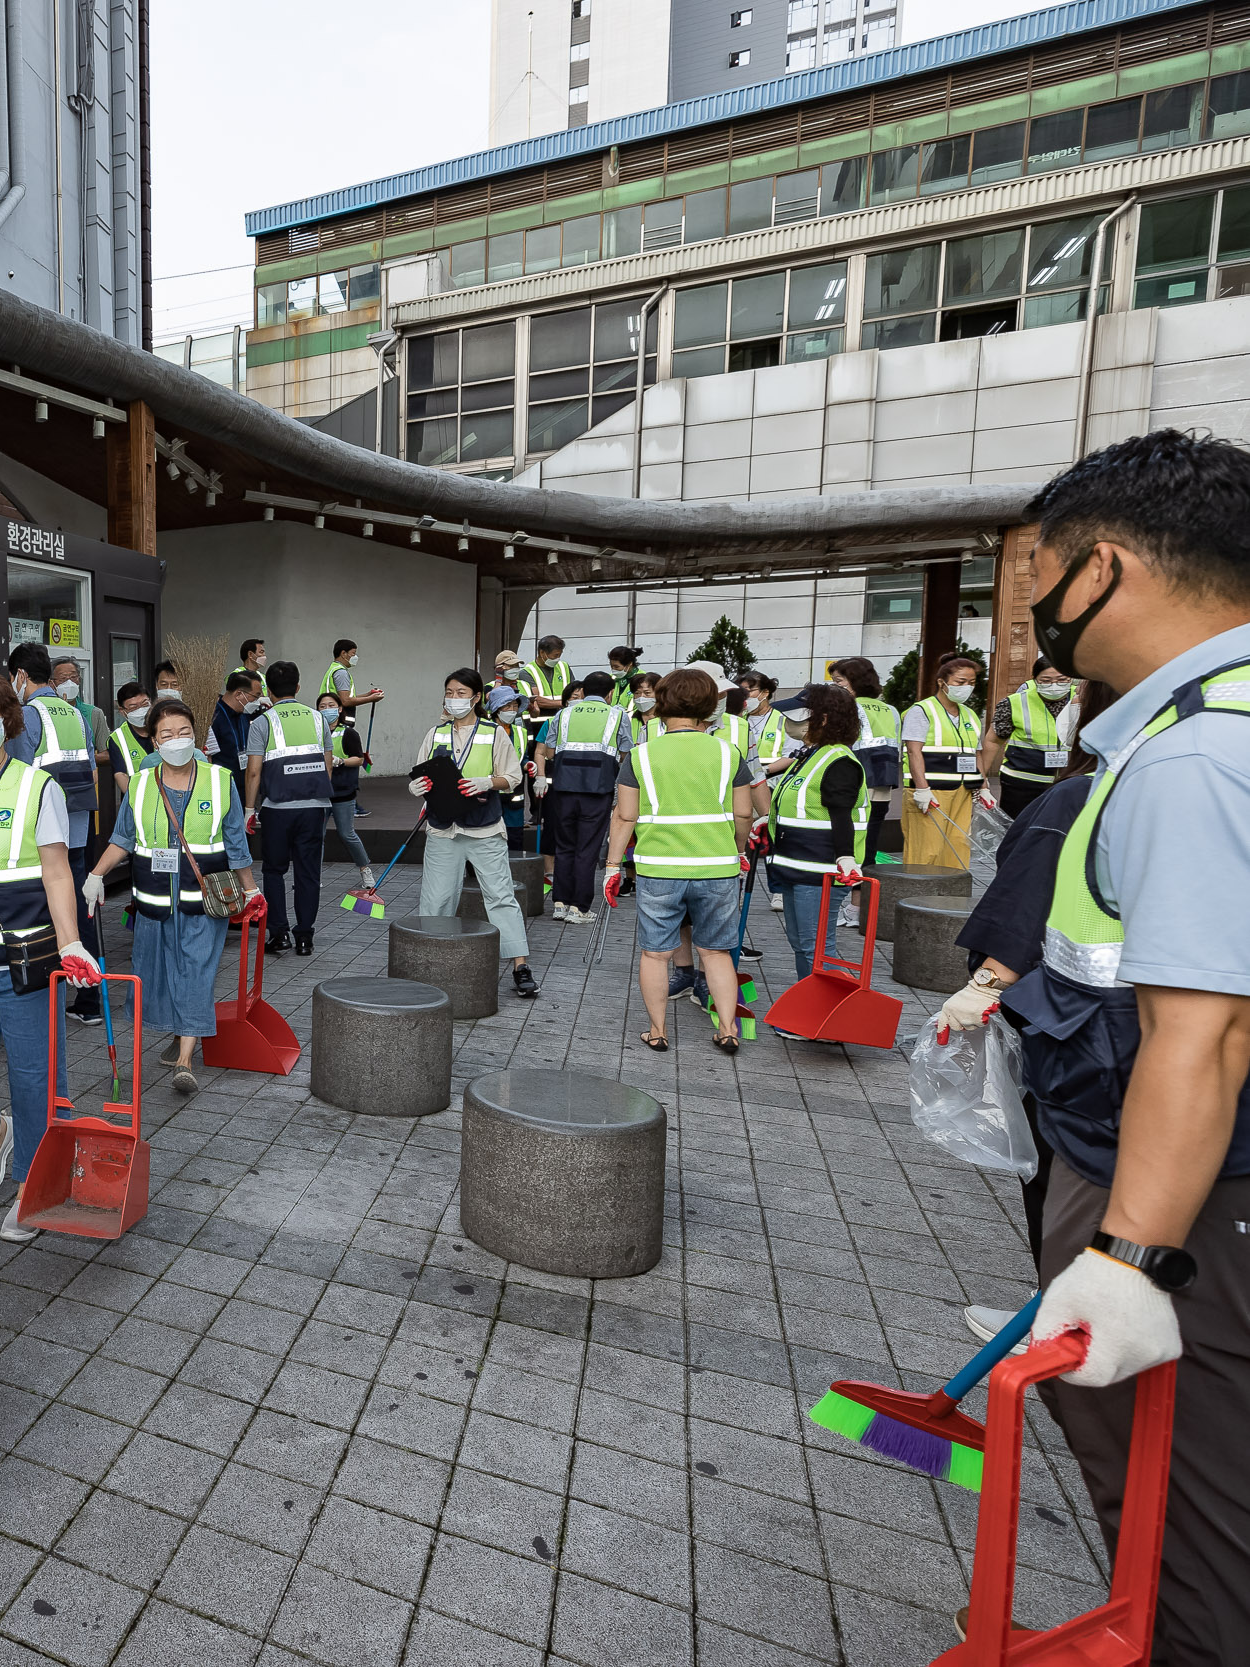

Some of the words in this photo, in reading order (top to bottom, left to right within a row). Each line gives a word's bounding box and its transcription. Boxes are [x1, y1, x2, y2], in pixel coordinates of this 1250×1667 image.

[7, 521, 65, 561] 환경관리실
[47, 706, 76, 716] 광진구
[278, 709, 312, 719] 광진구
